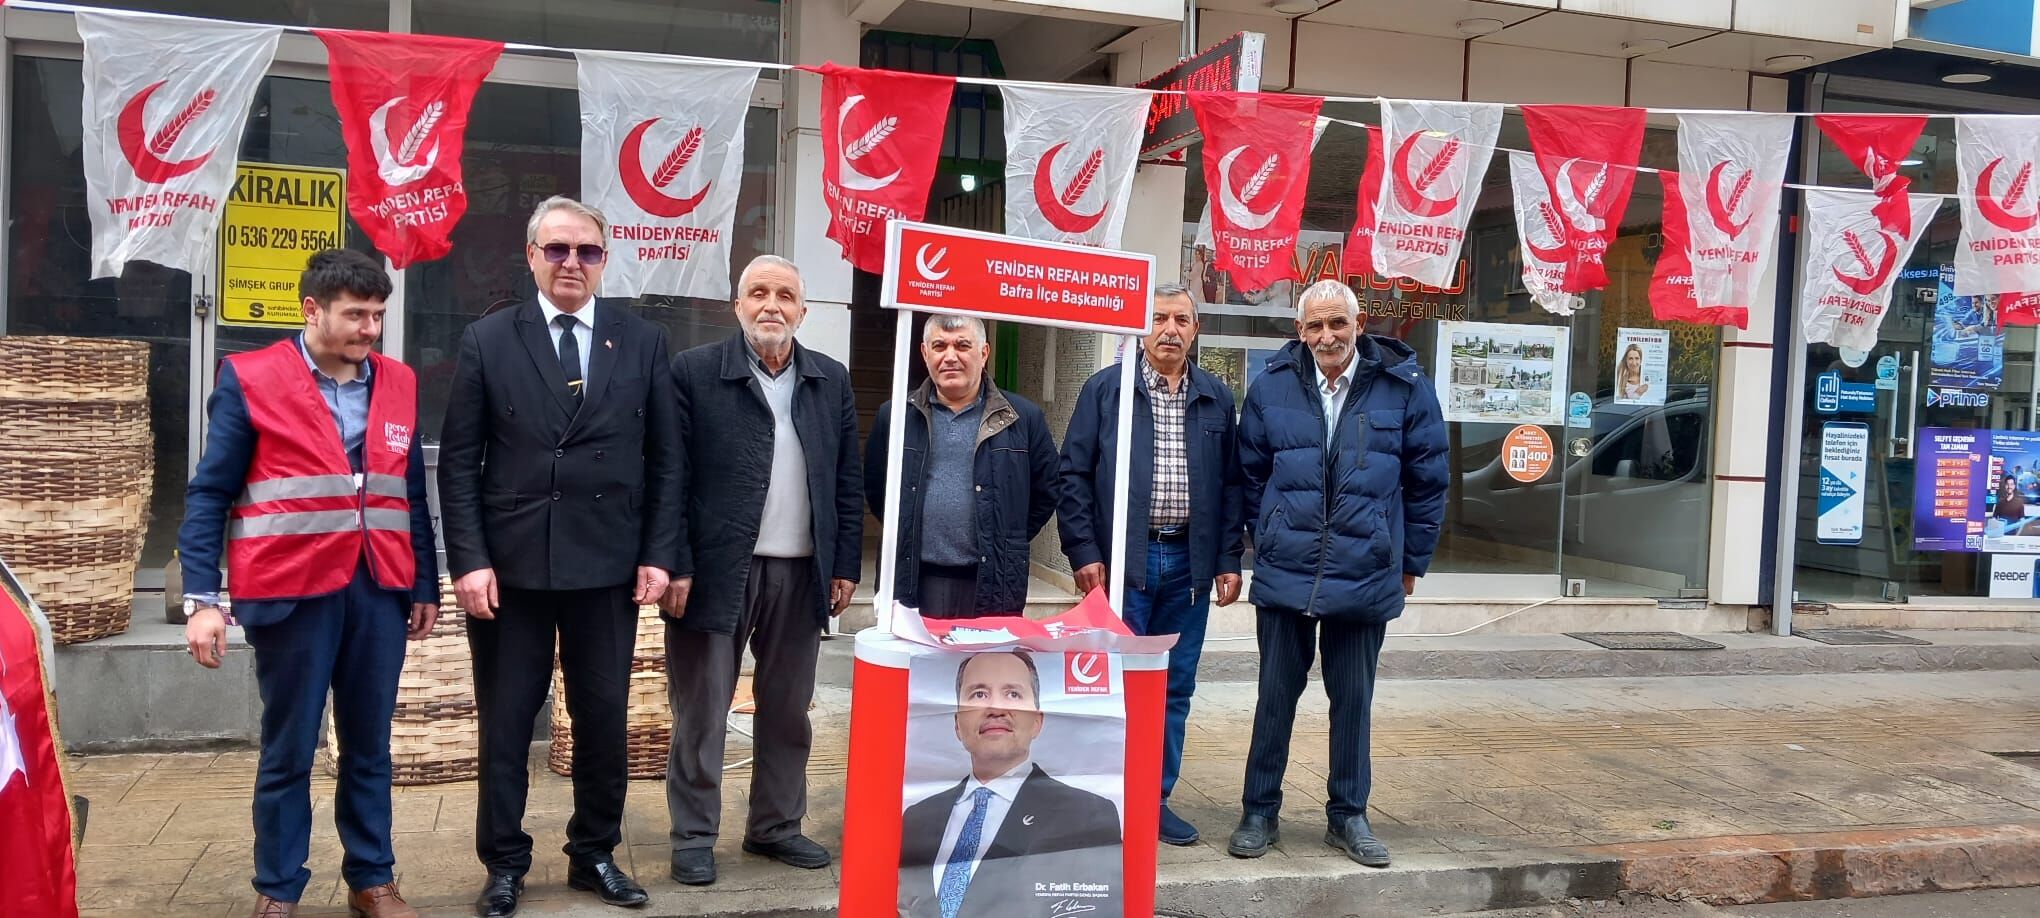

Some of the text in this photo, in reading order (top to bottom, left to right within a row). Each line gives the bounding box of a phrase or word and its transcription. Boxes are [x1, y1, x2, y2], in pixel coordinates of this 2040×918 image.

[229, 170, 336, 208] KİRALIK
[423, 182, 463, 203] REFA
[228, 225, 336, 251] 0 536 229 5564
[674, 226, 719, 243] REFAH
[1378, 221, 1433, 238] ENİDEN
[638, 243, 690, 261] PARTİSİ
[985, 258, 1140, 292] YENİDEN REFAH PARTİSİ
[229, 277, 296, 292] ŞİMŞEK GRUP
[908, 280, 955, 291] YENİDEN REFAH
[919, 289, 943, 298] PARTİSİ
[1000, 282, 1124, 311] Bafra İlçe Başkanlığı
[1939, 392, 1989, 408] prime
[1528, 451, 1548, 461] 400
[1049, 882, 1071, 891] Fatih
[1073, 882, 1109, 892] Erbakan
